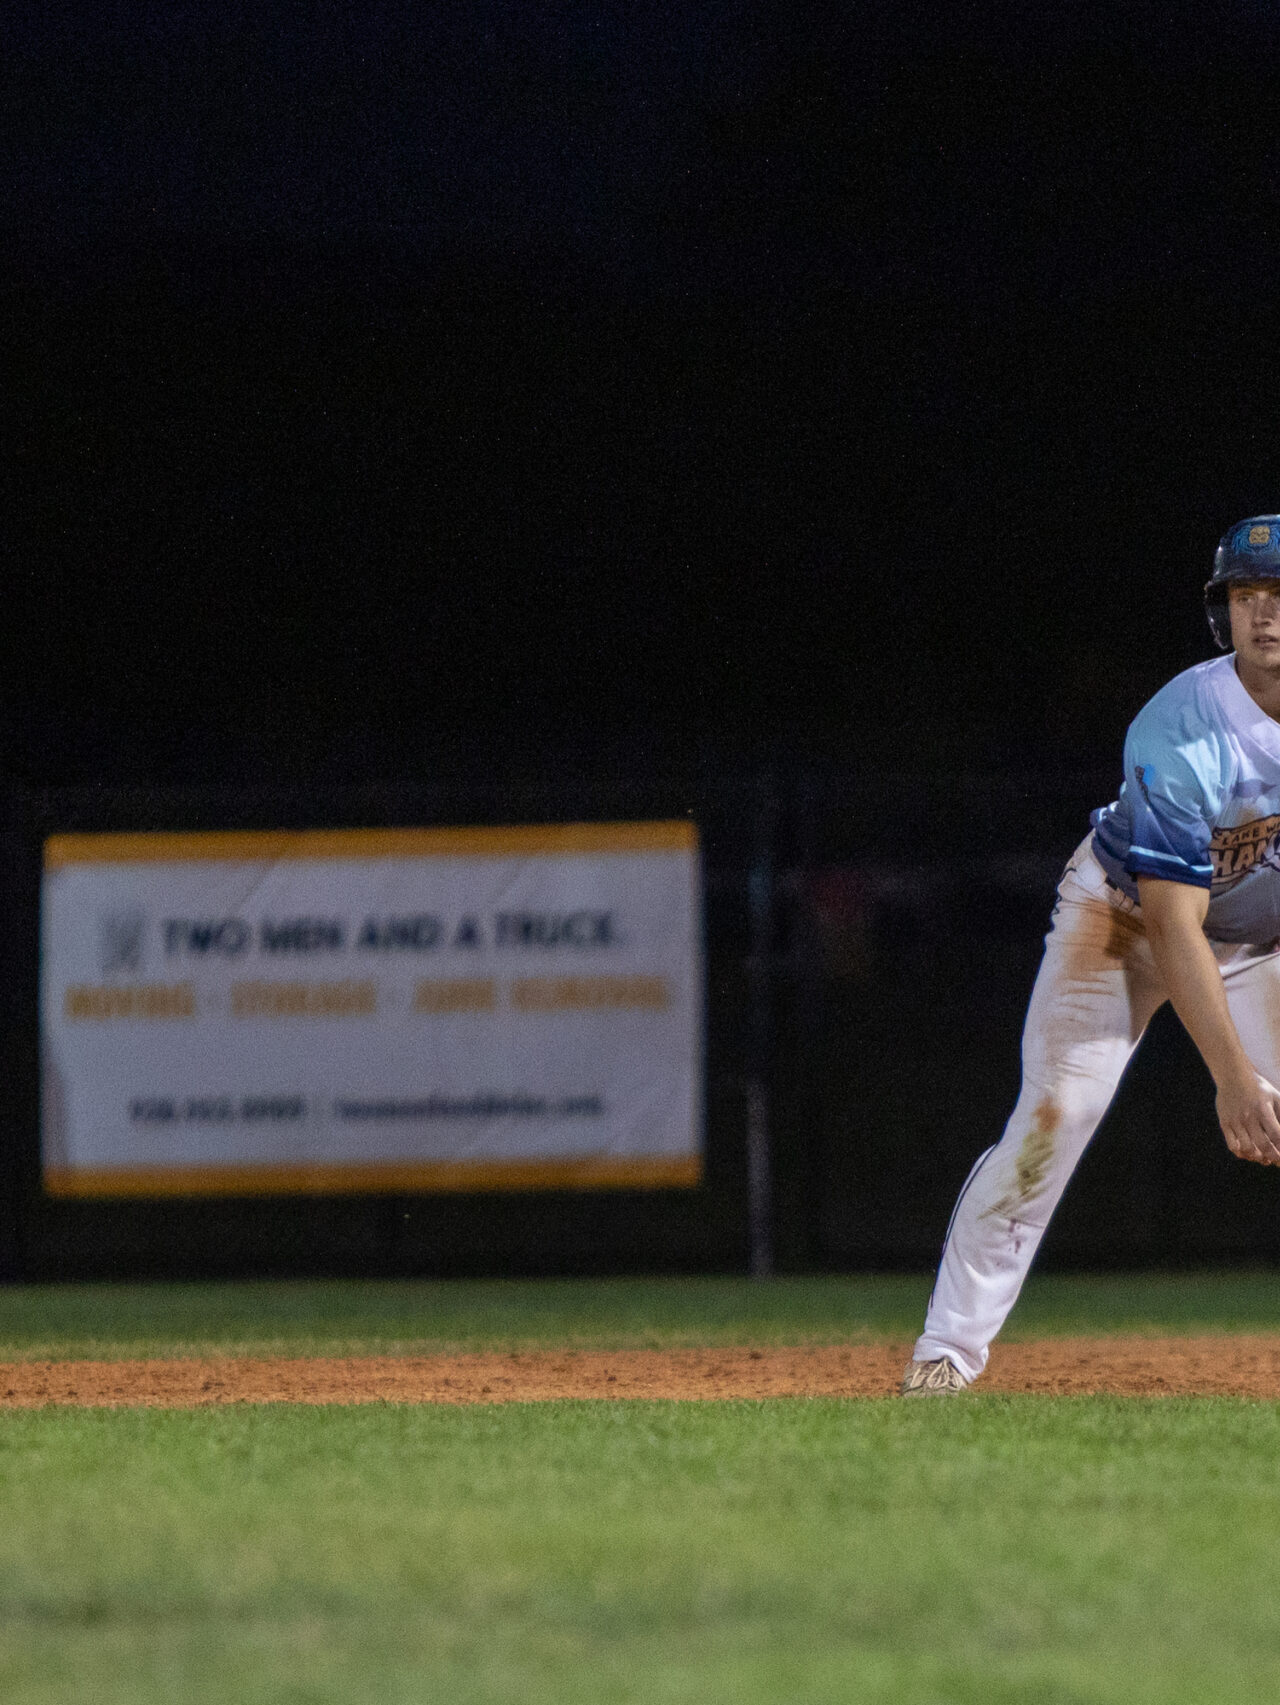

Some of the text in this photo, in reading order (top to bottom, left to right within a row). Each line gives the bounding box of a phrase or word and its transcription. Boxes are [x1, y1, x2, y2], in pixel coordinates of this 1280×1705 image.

[1222, 826, 1260, 846] LAKE
[162, 915, 251, 957] TWO
[260, 914, 344, 955] MEN
[355, 912, 441, 951] AND
[452, 912, 482, 949] A
